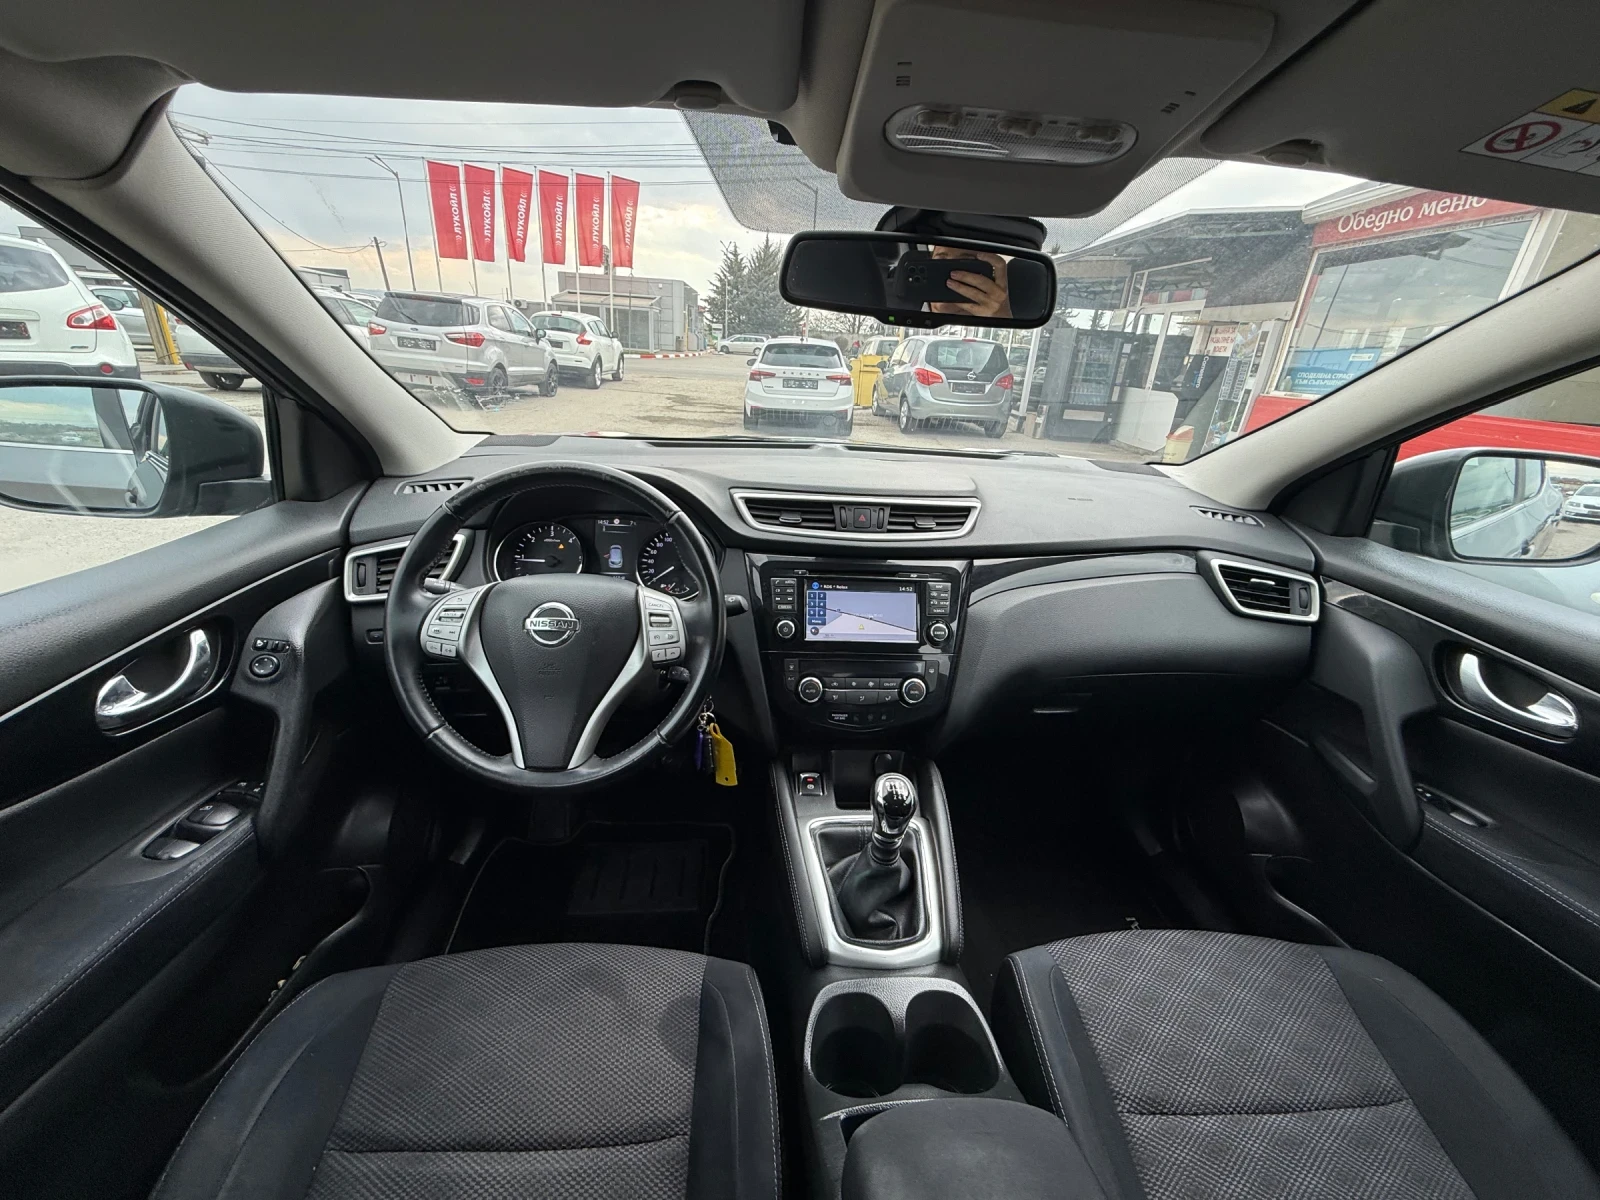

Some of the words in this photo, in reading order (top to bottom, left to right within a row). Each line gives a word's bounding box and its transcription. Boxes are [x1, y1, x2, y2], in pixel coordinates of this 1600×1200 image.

[449, 192, 462, 234] ЛУКОЙЛ
[482, 195, 491, 237] ЛУКОЙЛ
[516, 197, 527, 238] ЛУКОЙЛ
[554, 200, 564, 240] ЛУКОЙЛ
[591, 203, 600, 243] ЛУКОЙЛ
[624, 206, 633, 247] ЛУКОЙЛ
[1338, 206, 1414, 233] Обедно
[1417, 195, 1488, 219] меню
[530, 620, 573, 629] NISSAN
